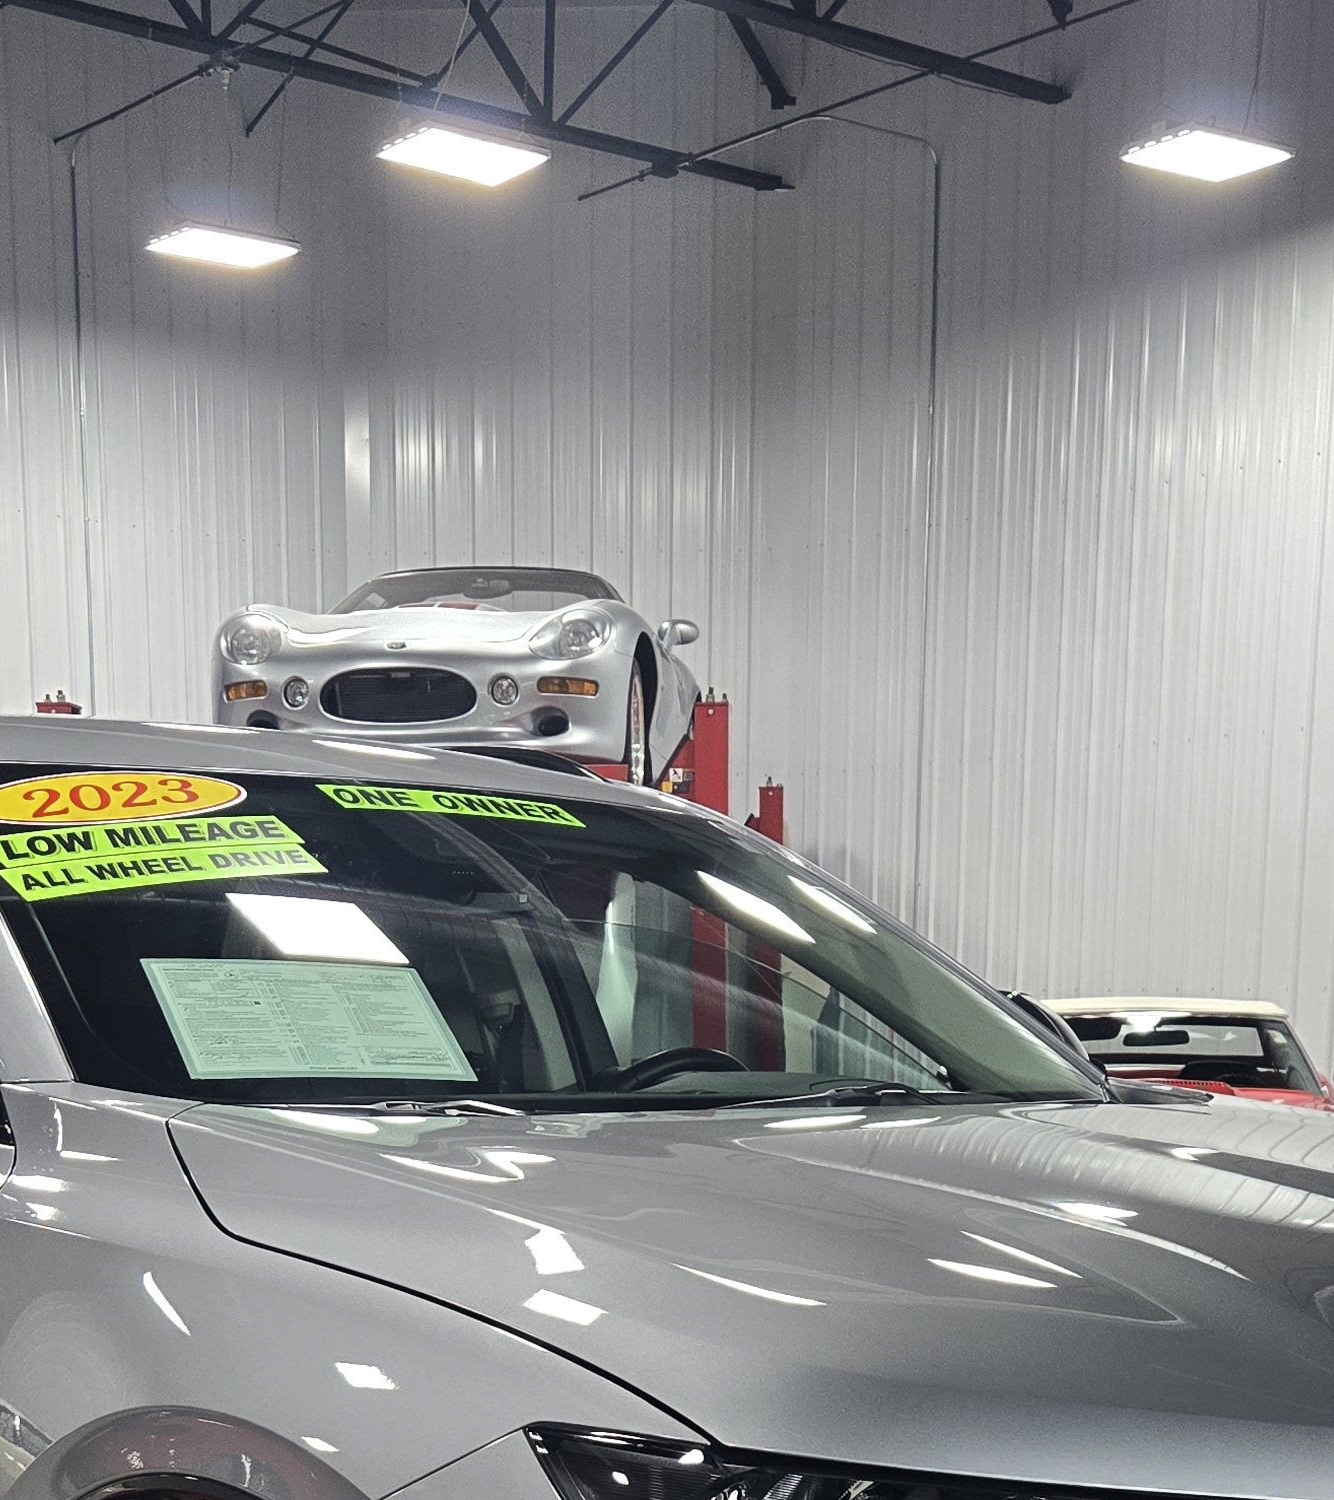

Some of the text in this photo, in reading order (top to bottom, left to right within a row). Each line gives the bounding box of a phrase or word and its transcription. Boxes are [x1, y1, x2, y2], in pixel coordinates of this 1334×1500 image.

[22, 778, 198, 819] 2023
[333, 786, 567, 822] ONE OWNER
[4, 818, 287, 861] LOW MILEAGE
[22, 846, 308, 892] ALL WHEEL DRIVE
